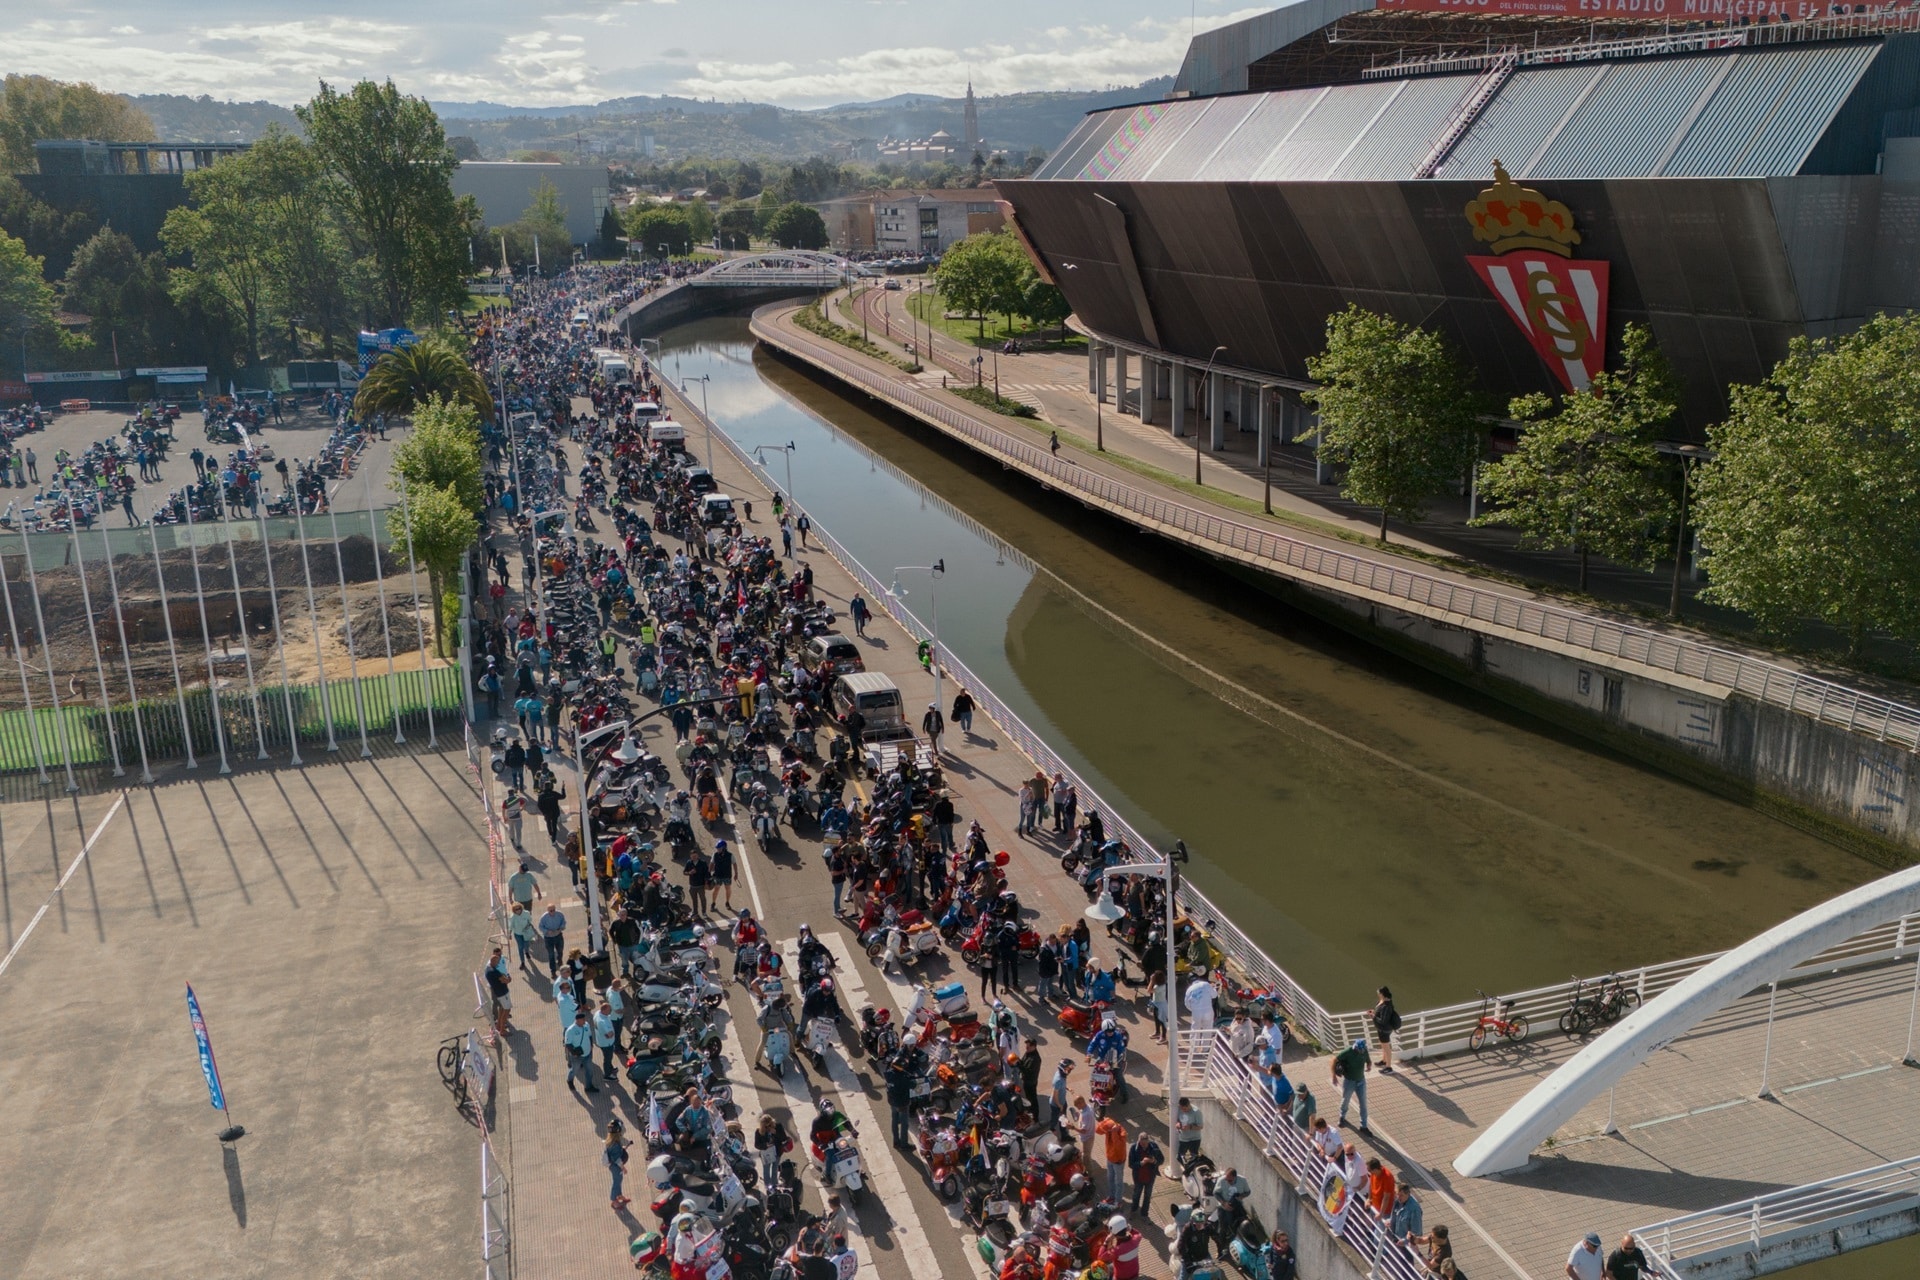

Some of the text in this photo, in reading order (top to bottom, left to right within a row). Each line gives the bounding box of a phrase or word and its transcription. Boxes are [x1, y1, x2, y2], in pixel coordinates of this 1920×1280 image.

[1580, 0, 1666, 12] ESTADIO
[1684, 0, 1786, 15] MUNICIPAL
[1798, 2, 1816, 16] EL
